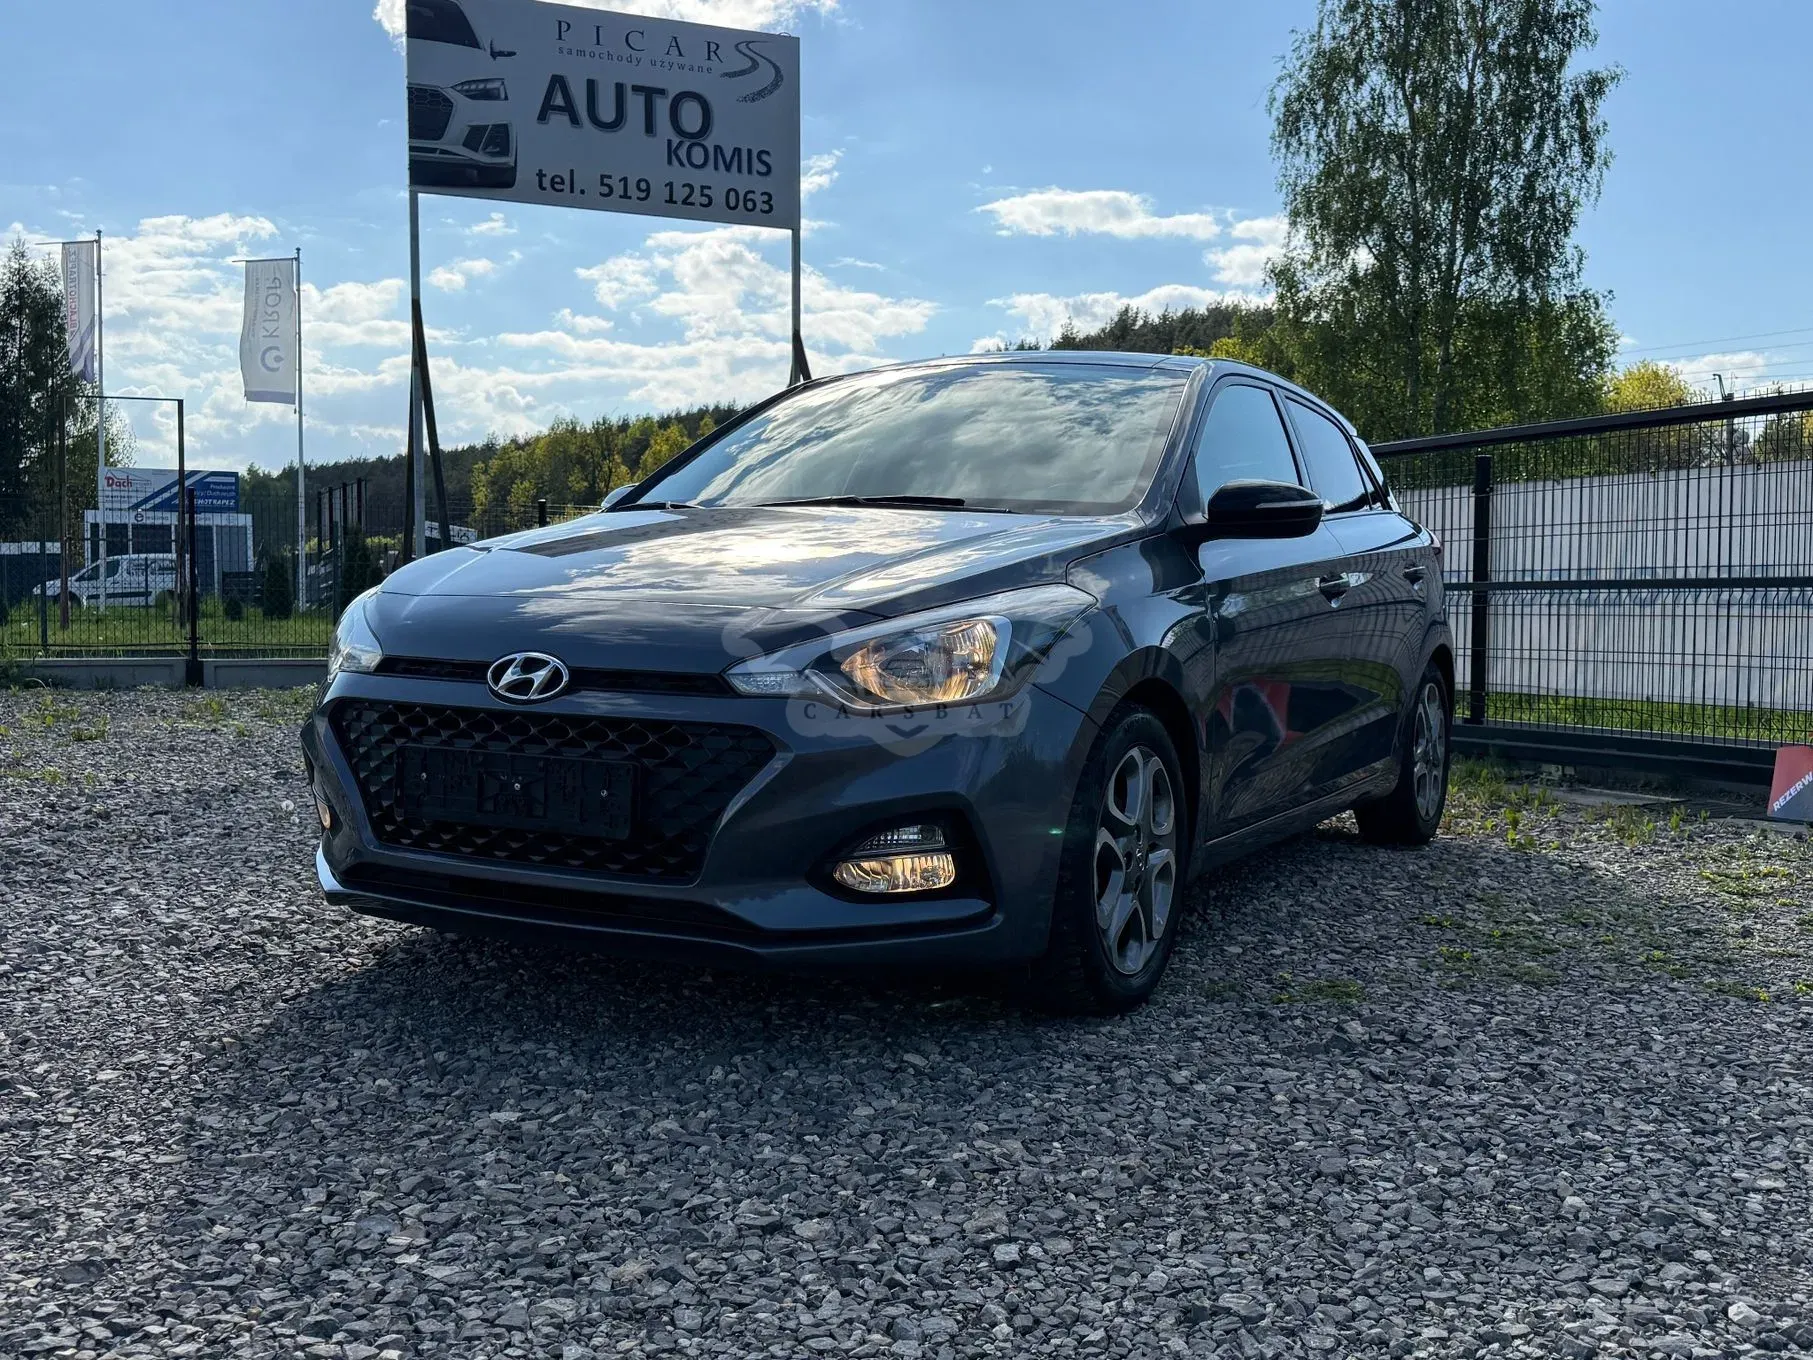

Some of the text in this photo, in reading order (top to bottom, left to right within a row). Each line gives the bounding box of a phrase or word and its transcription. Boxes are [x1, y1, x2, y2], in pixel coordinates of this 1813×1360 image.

[558, 45, 643, 67] samochody
[536, 73, 714, 141] AUTO
[666, 138, 774, 178] KOMIS
[535, 168, 774, 215] tel. 519 125 063
[104, 475, 133, 488] Dach
